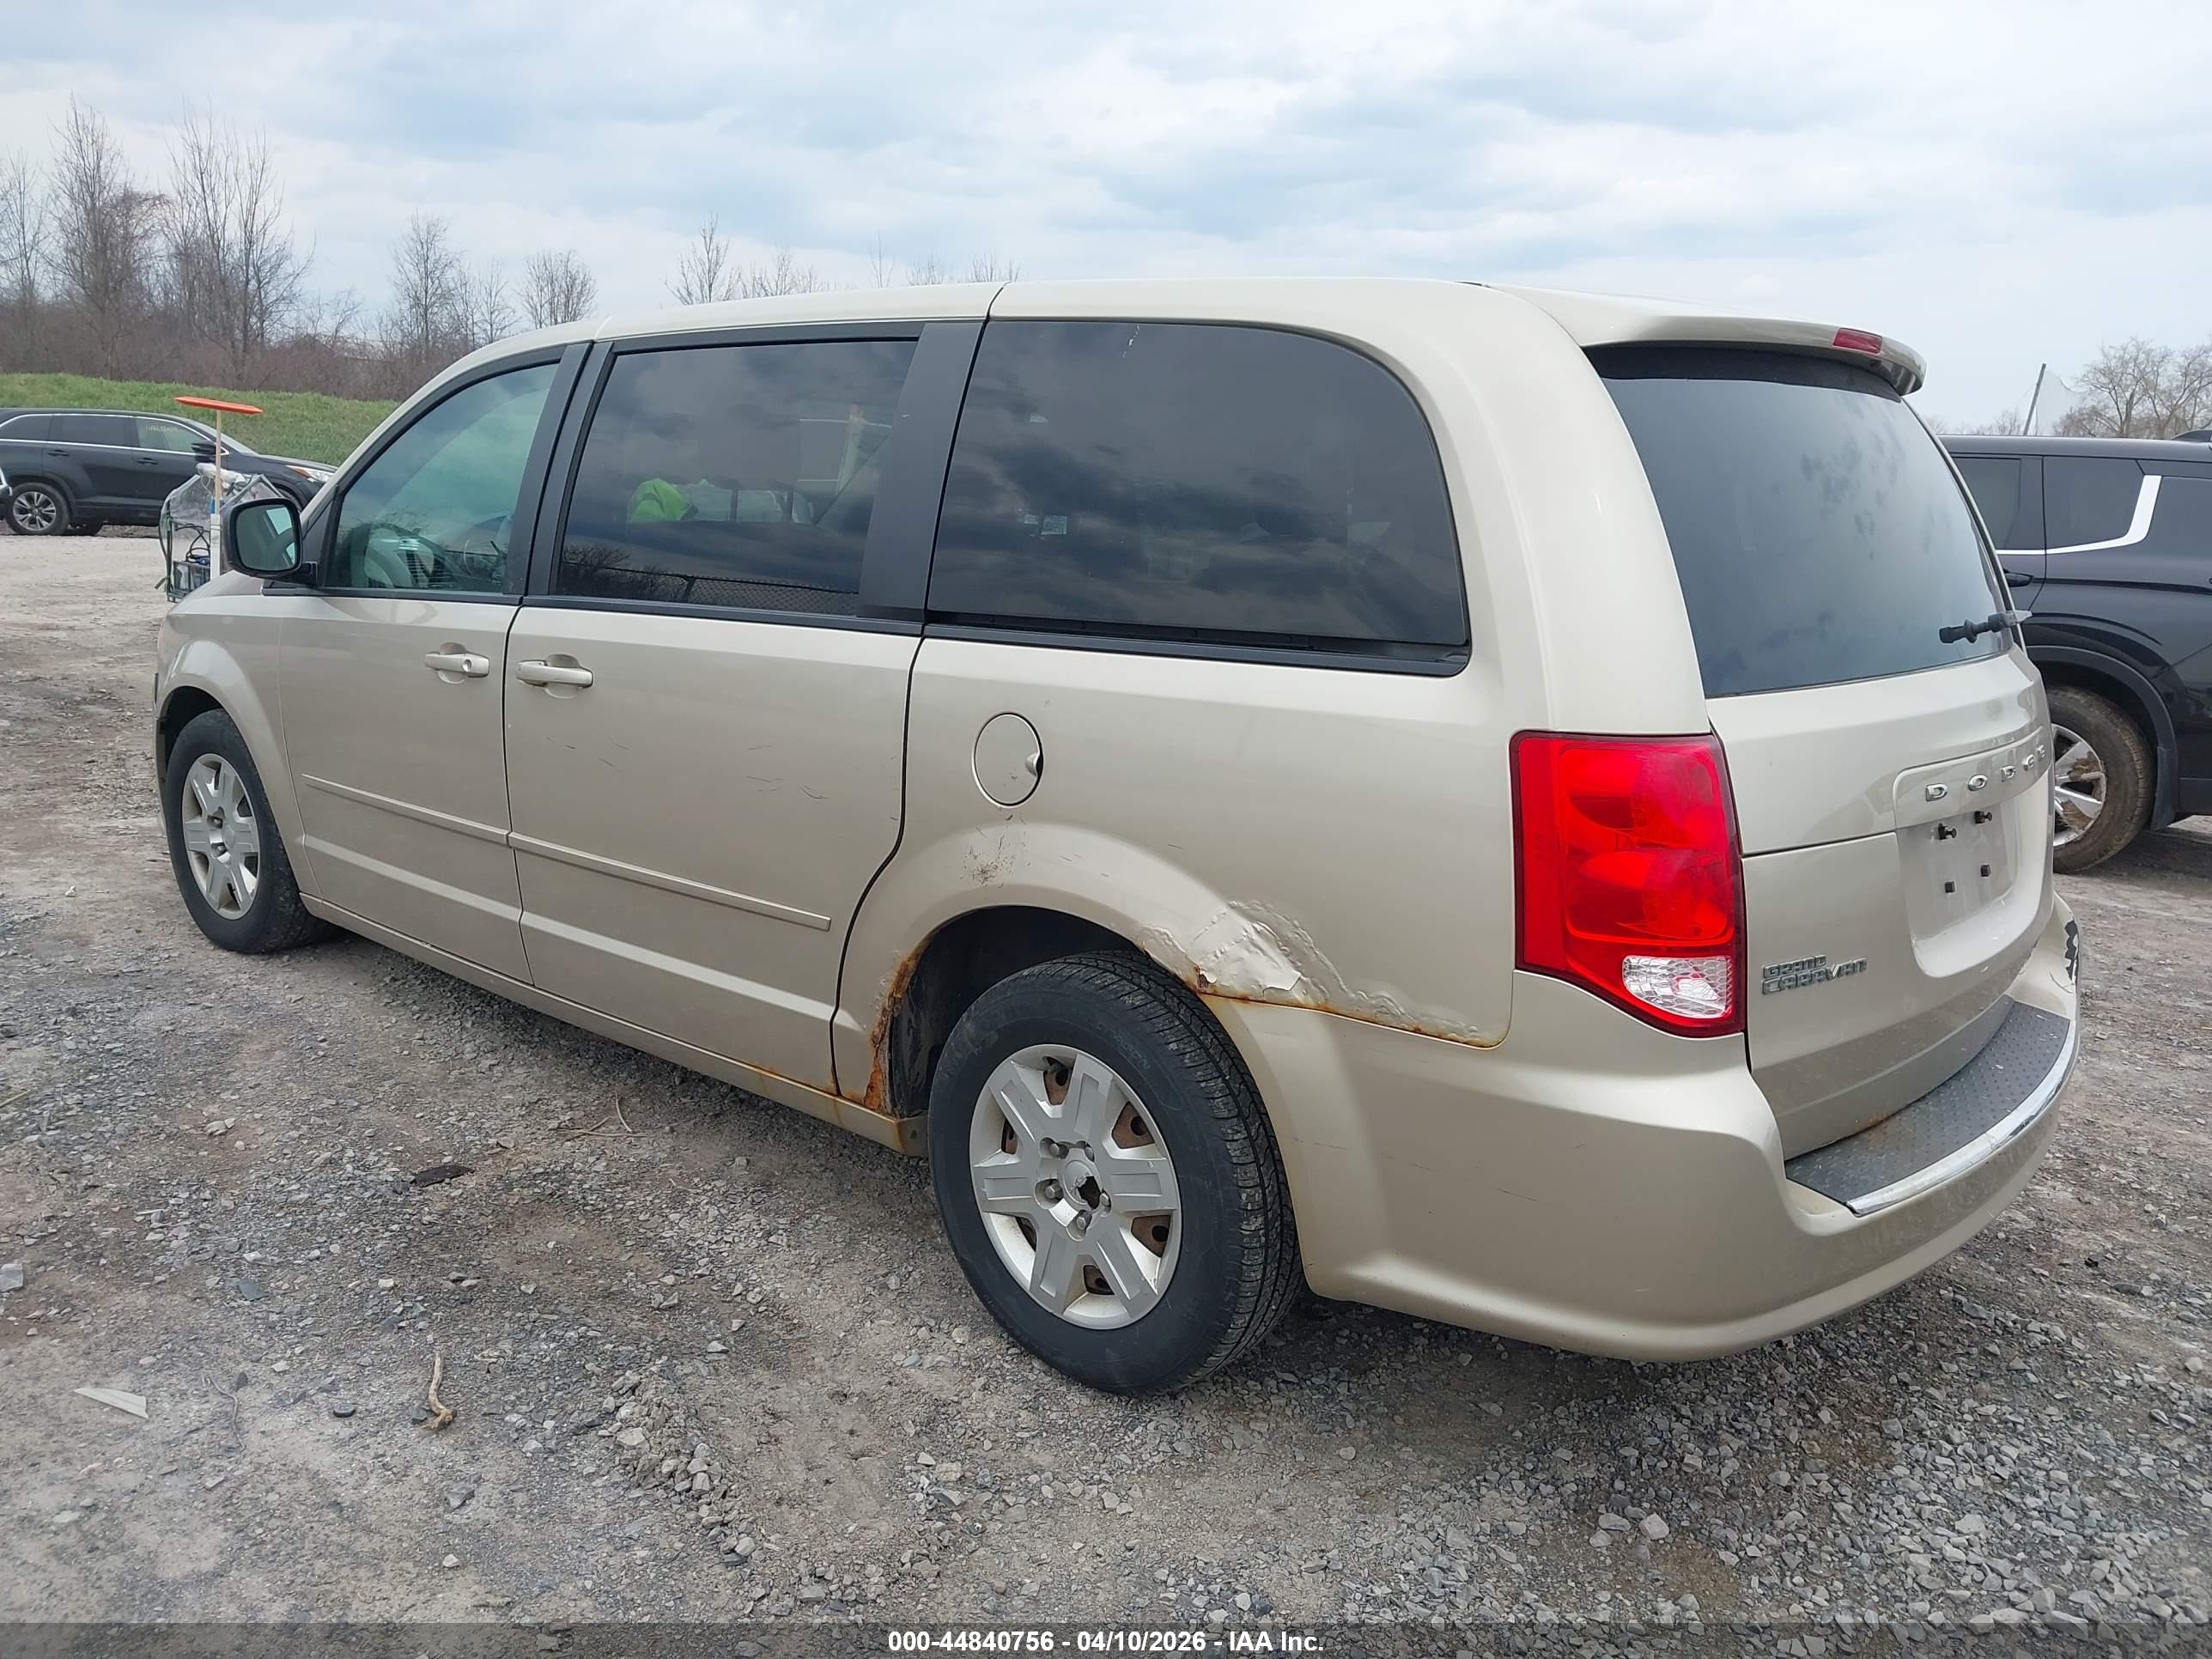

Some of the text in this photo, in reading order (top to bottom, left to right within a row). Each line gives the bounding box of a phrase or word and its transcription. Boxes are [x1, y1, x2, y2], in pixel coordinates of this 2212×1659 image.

[1926, 744, 2047, 802] DODGE
[1762, 957, 1868, 994] CARAVAN
[1763, 954, 1826, 979] GRAND
